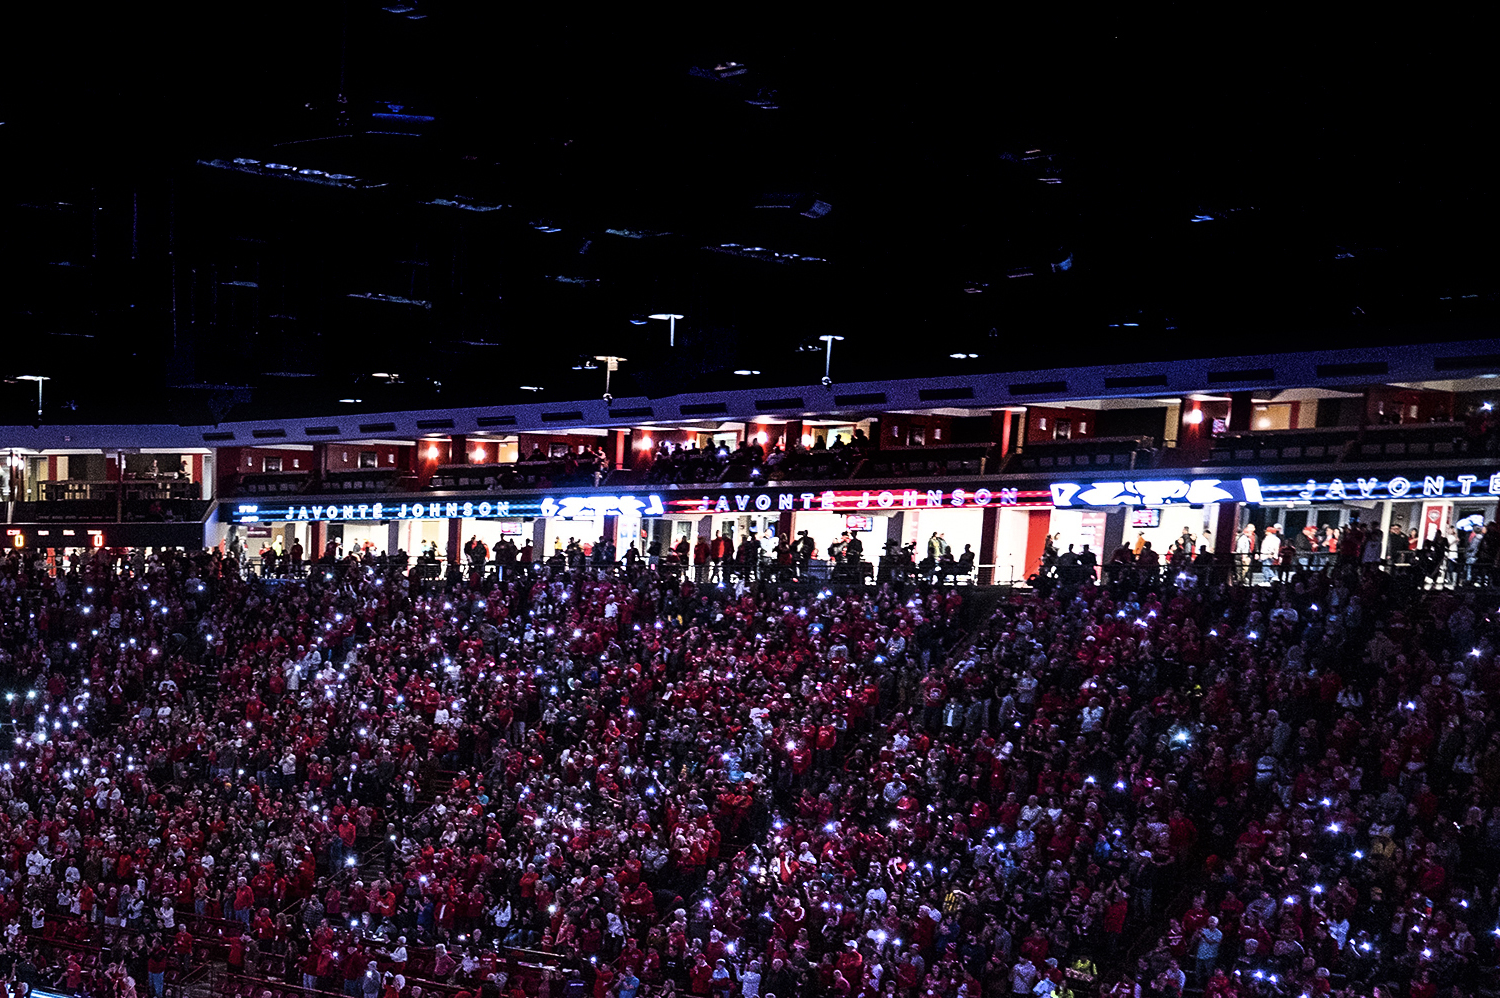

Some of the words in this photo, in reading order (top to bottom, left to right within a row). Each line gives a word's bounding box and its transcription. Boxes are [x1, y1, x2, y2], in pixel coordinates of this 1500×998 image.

[856, 488, 1018, 508] JOHNSON
[398, 501, 510, 519] JOHNSON
[14, 534, 24, 547] 0
[94, 534, 103, 547] 0
